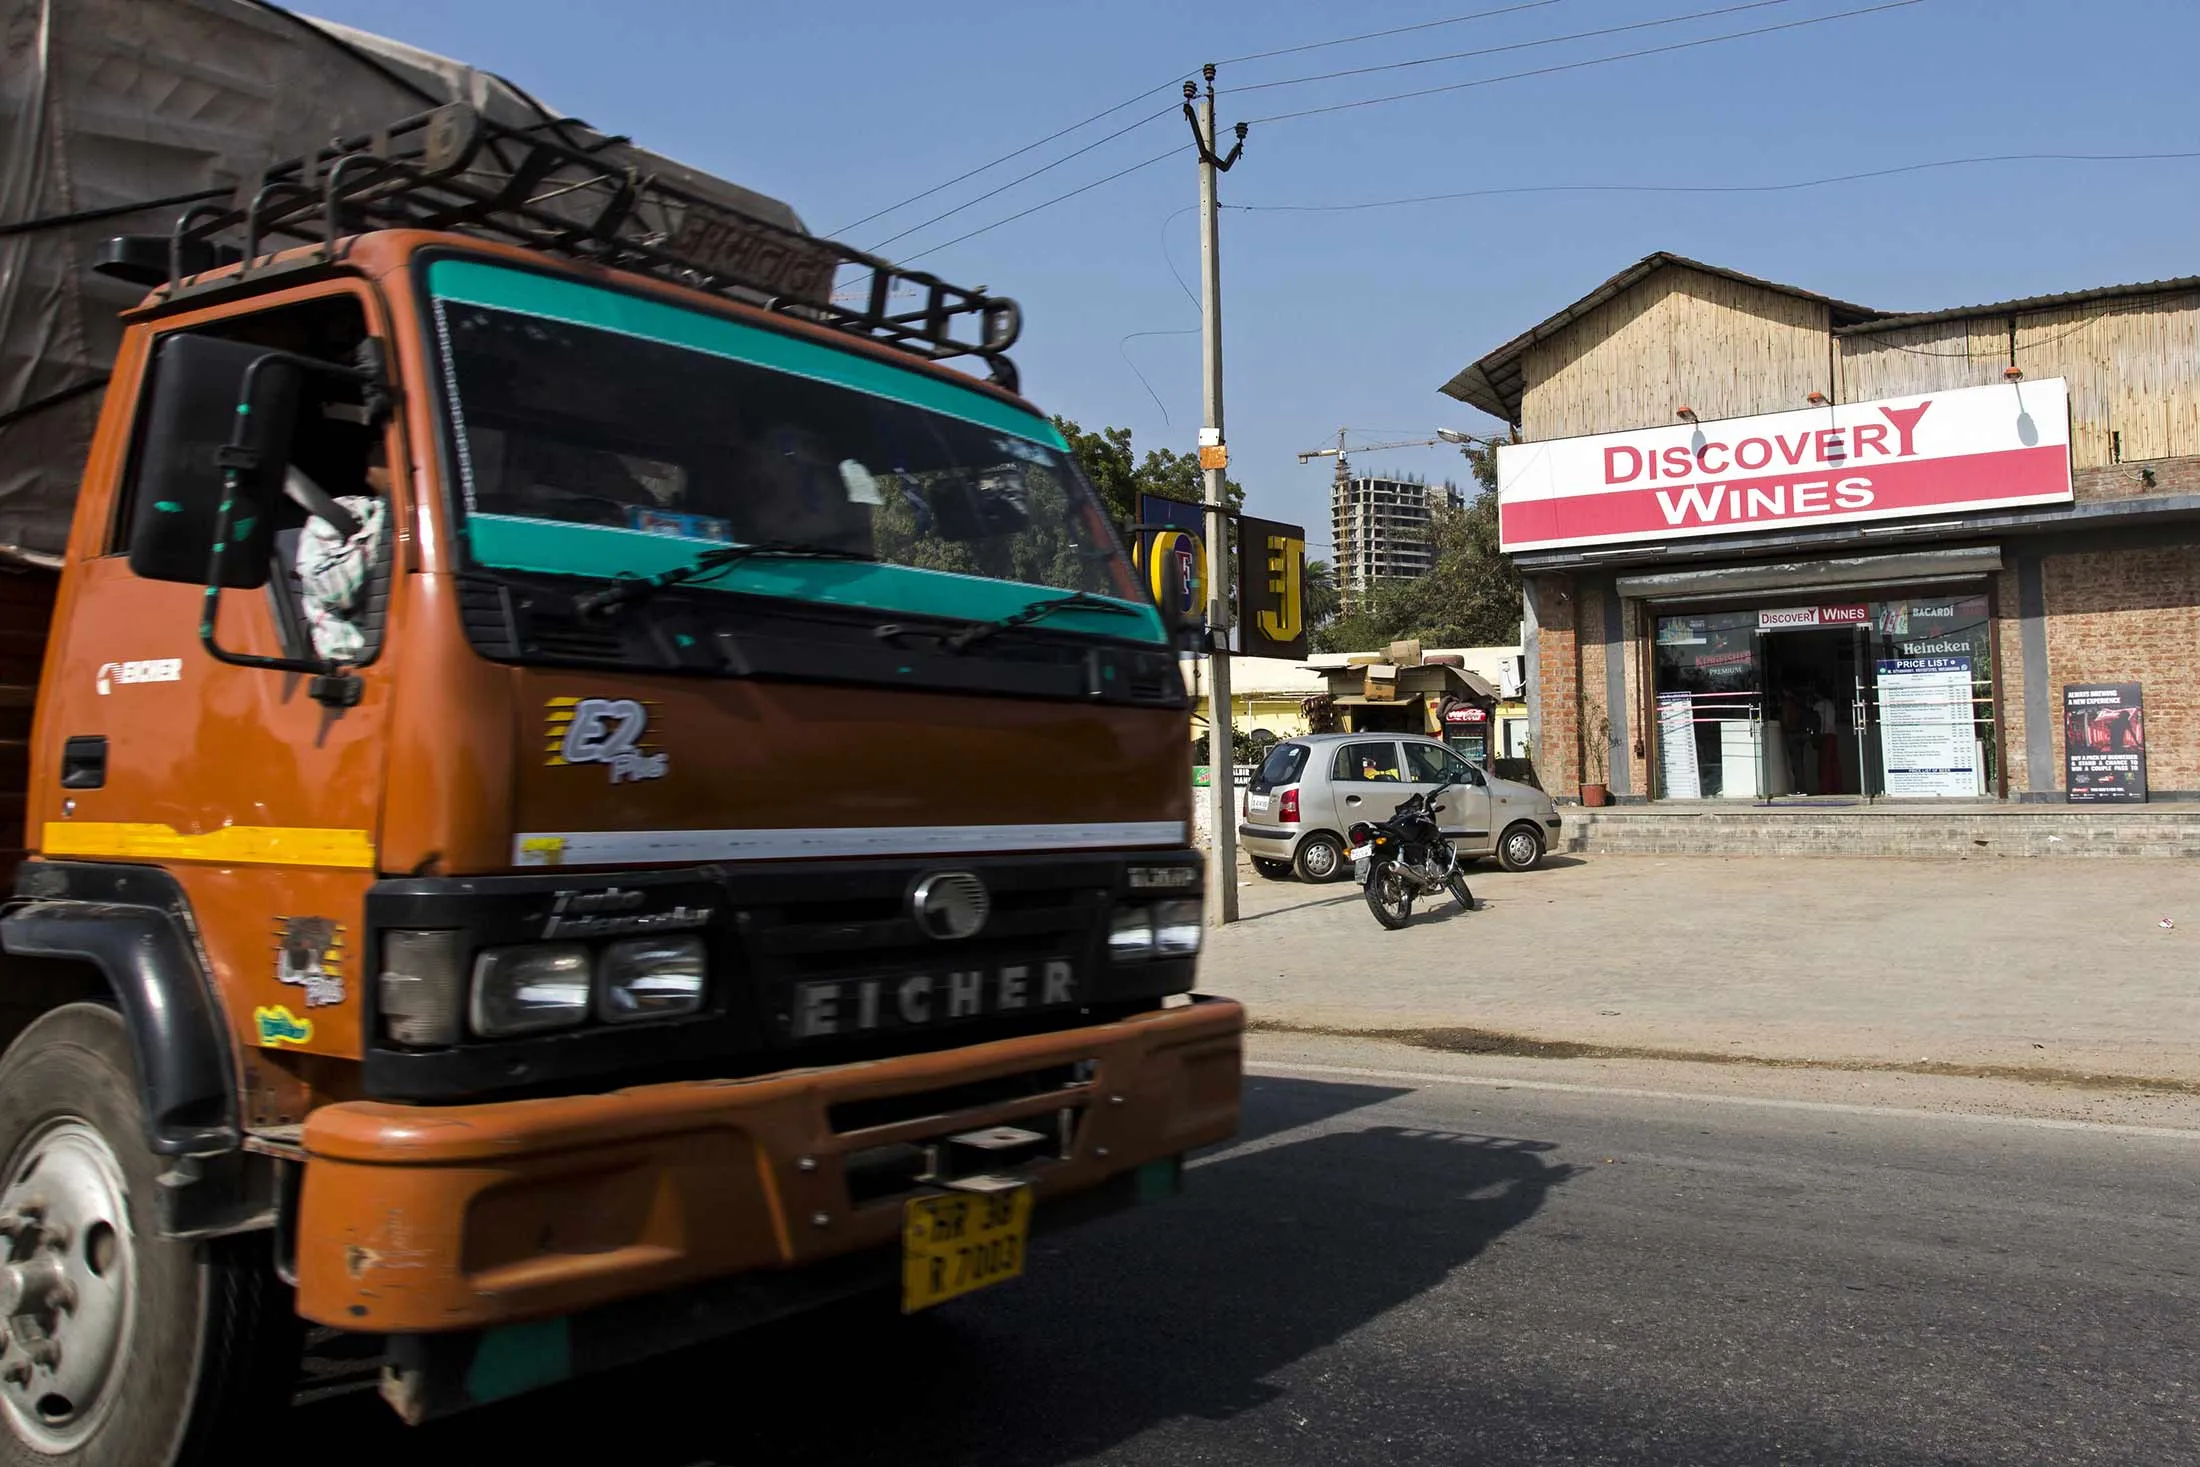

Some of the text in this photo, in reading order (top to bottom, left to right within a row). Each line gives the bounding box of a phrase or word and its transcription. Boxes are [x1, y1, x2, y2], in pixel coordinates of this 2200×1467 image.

[1604, 400, 1932, 484] DISCOVERY
[1656, 477, 1874, 525] WINES
[1762, 608, 1817, 624] DISCOVERY
[1822, 608, 1865, 620] WINES
[1912, 605, 1954, 617] BACARDÍ
[1903, 641, 1971, 655] Heineken
[1896, 659, 1949, 669] PRICE LIST
[795, 960, 1074, 1038] EICHER
